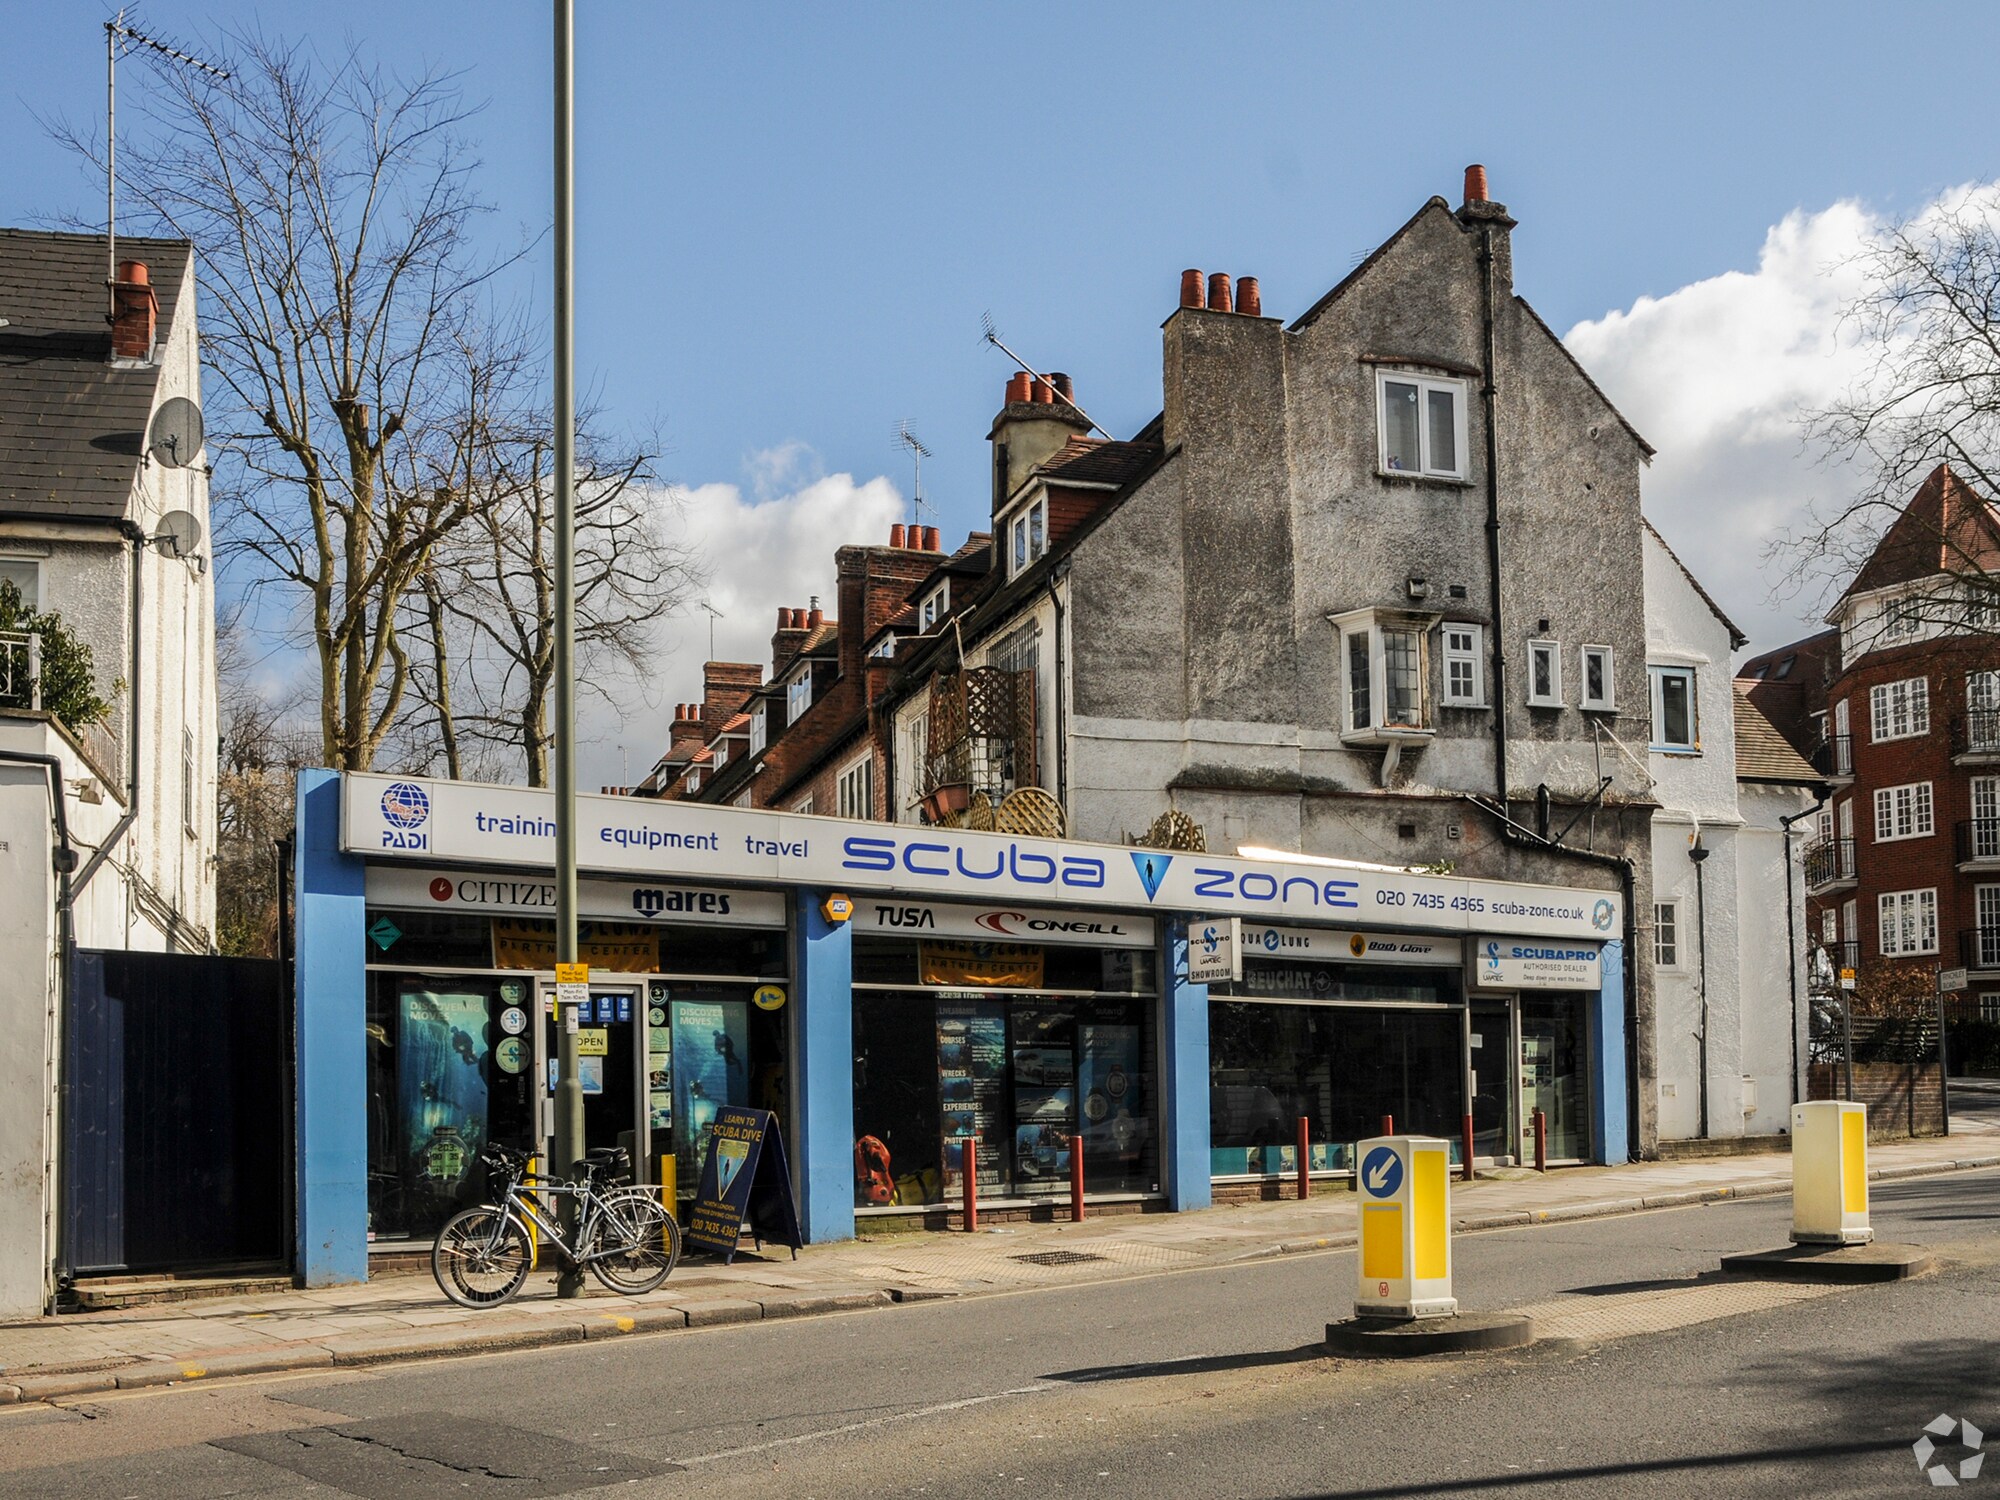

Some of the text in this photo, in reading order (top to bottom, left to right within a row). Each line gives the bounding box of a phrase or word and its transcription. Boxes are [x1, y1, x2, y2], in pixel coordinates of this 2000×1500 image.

[382, 831, 427, 849] PADI
[475, 811, 809, 857] trainin equipment travel
[457, 880, 557, 907] CITIZE
[633, 887, 730, 915] mares
[1376, 890, 1406, 906] 020
[1412, 892, 1446, 909] 7435
[1450, 896, 1485, 912] 4365
[1491, 900, 1584, 920] scuba-zone.co.uk
[875, 905, 934, 928] TUSA
[1028, 919, 1127, 935] O'NEILL
[1241, 932, 1310, 948] QUA LUNG
[1368, 941, 1433, 954] Body Glove
[1512, 947, 1597, 961] SCUBAPRO
[1191, 968, 1231, 979] SHOWROOM
[1523, 963, 1588, 972] AUTHORISED DEALER
[1247, 970, 1312, 990] BEUCHAT
[577, 1038, 604, 1046] OPEN
[723, 1114, 756, 1126] LEARN TO
[713, 1124, 762, 1142] SCUBA DIVE
[691, 1218, 738, 1238] 020 7435 4365
